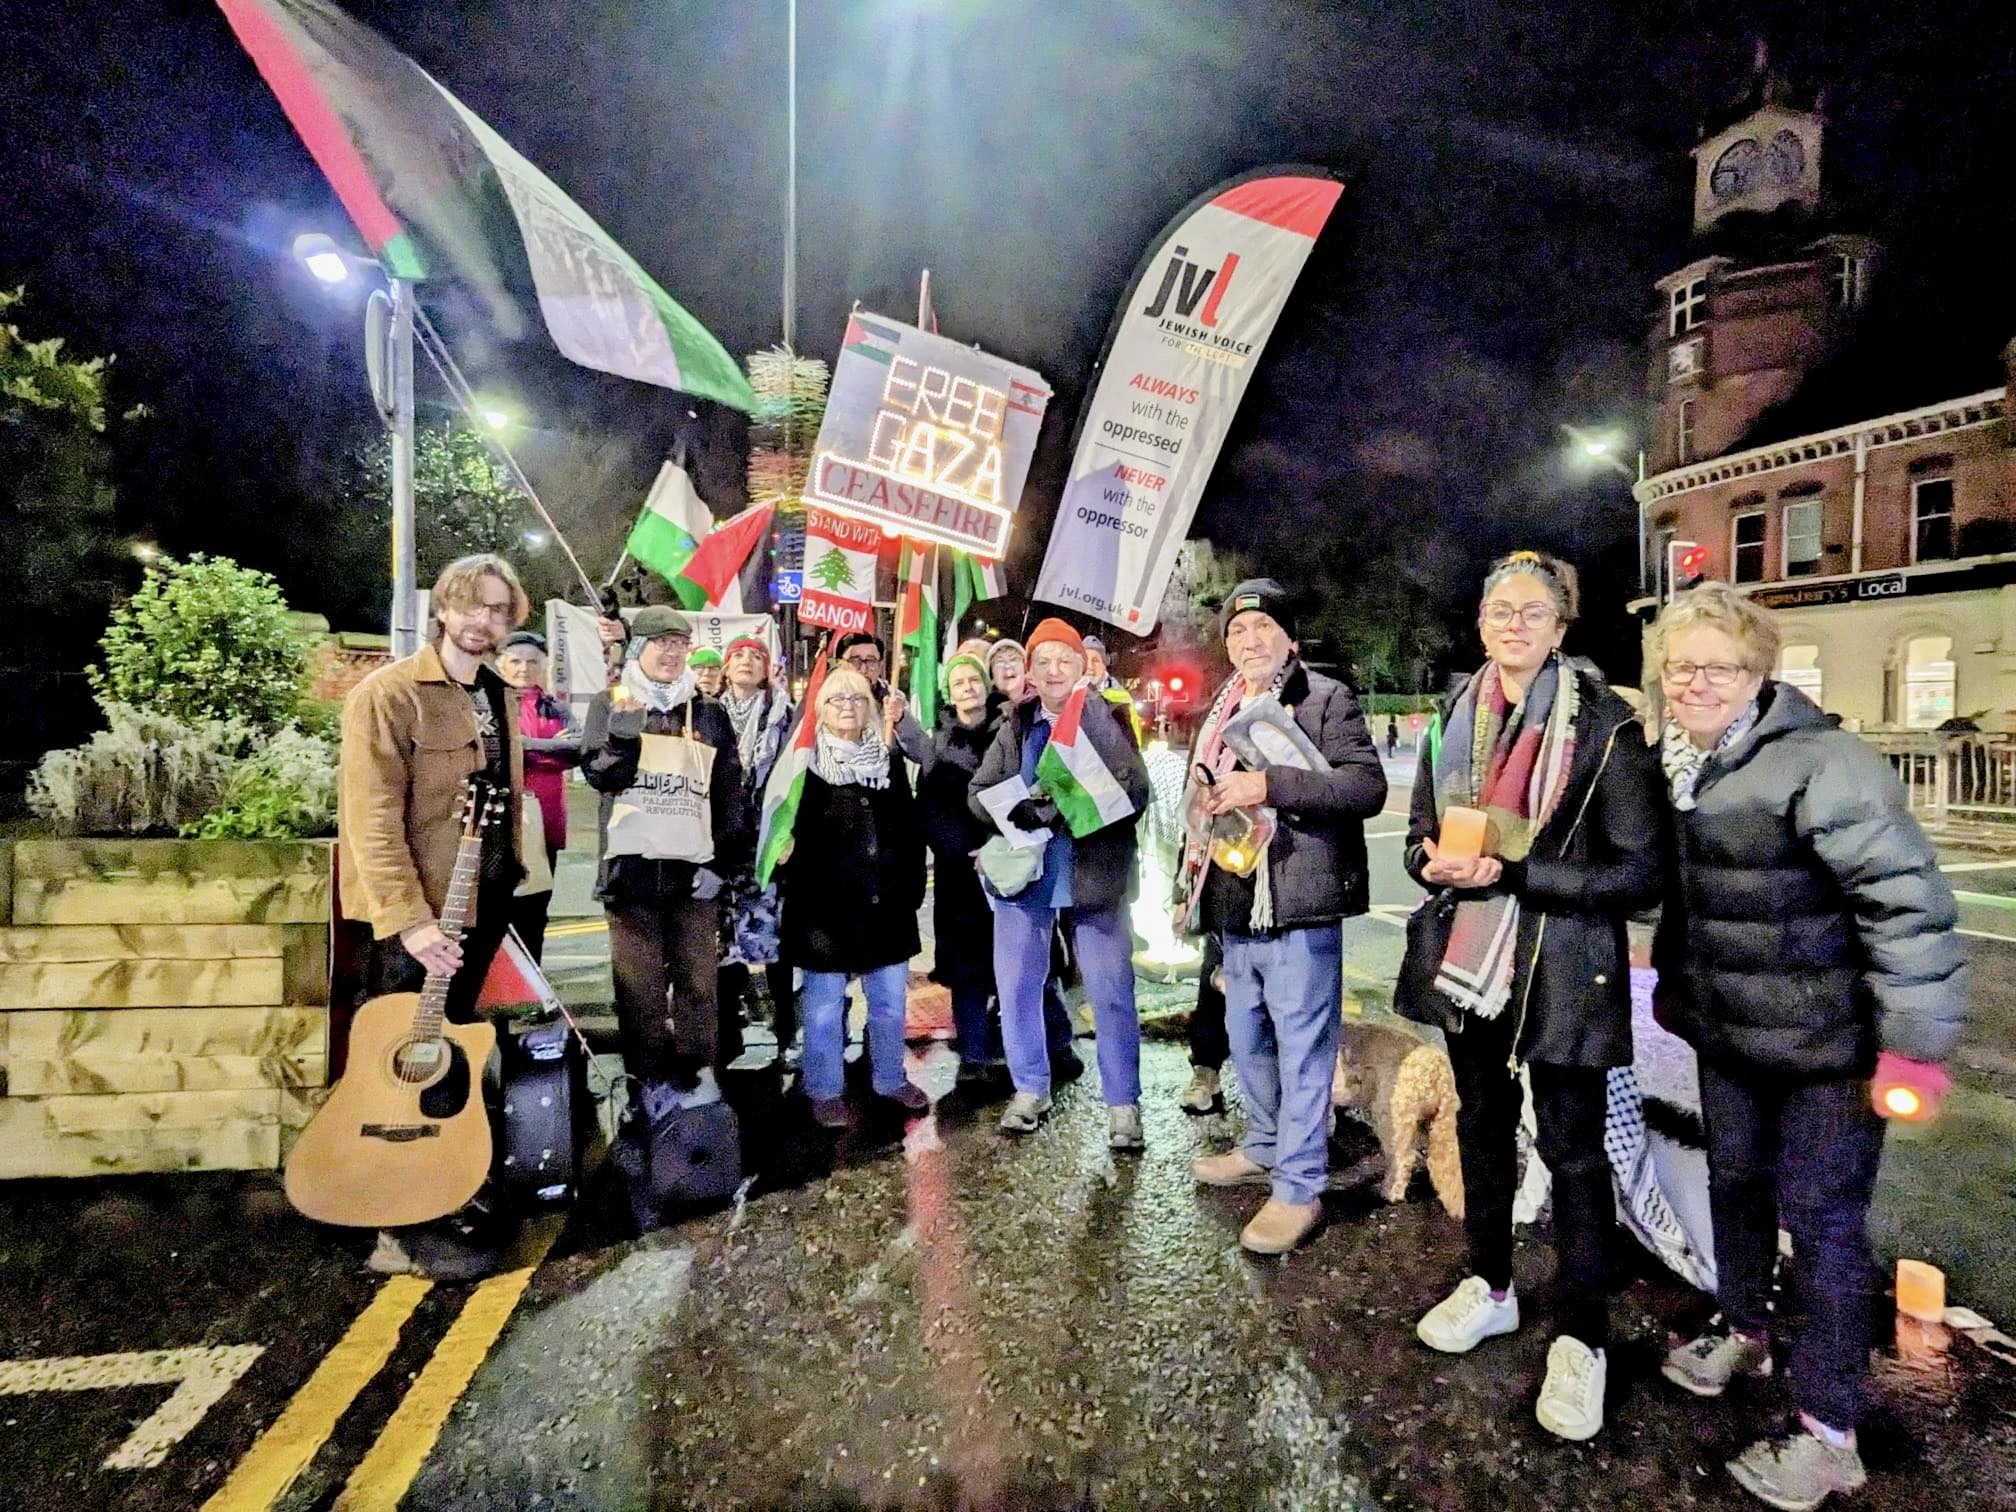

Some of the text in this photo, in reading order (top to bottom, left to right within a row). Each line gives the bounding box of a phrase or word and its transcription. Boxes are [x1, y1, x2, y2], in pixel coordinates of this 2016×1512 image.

[1143, 244, 1240, 328] jvl
[1159, 318, 1253, 355] JEWISH VOICE
[1161, 336, 1182, 349] FOR
[883, 354, 1007, 439] FREE
[1129, 373, 1199, 404] ALWAYS
[1131, 400, 1189, 430] with the
[1103, 419, 1183, 454] oppressed
[868, 409, 1003, 506] GAZA
[1114, 464, 1166, 492] NEVER
[819, 461, 999, 545] CEASEFIRE
[1103, 487, 1156, 516] with the
[809, 509, 850, 538] STAND
[1077, 506, 1148, 539] oppressor
[1059, 583, 1124, 616] jvl.org.uk
[1858, 575, 1908, 597] Local
